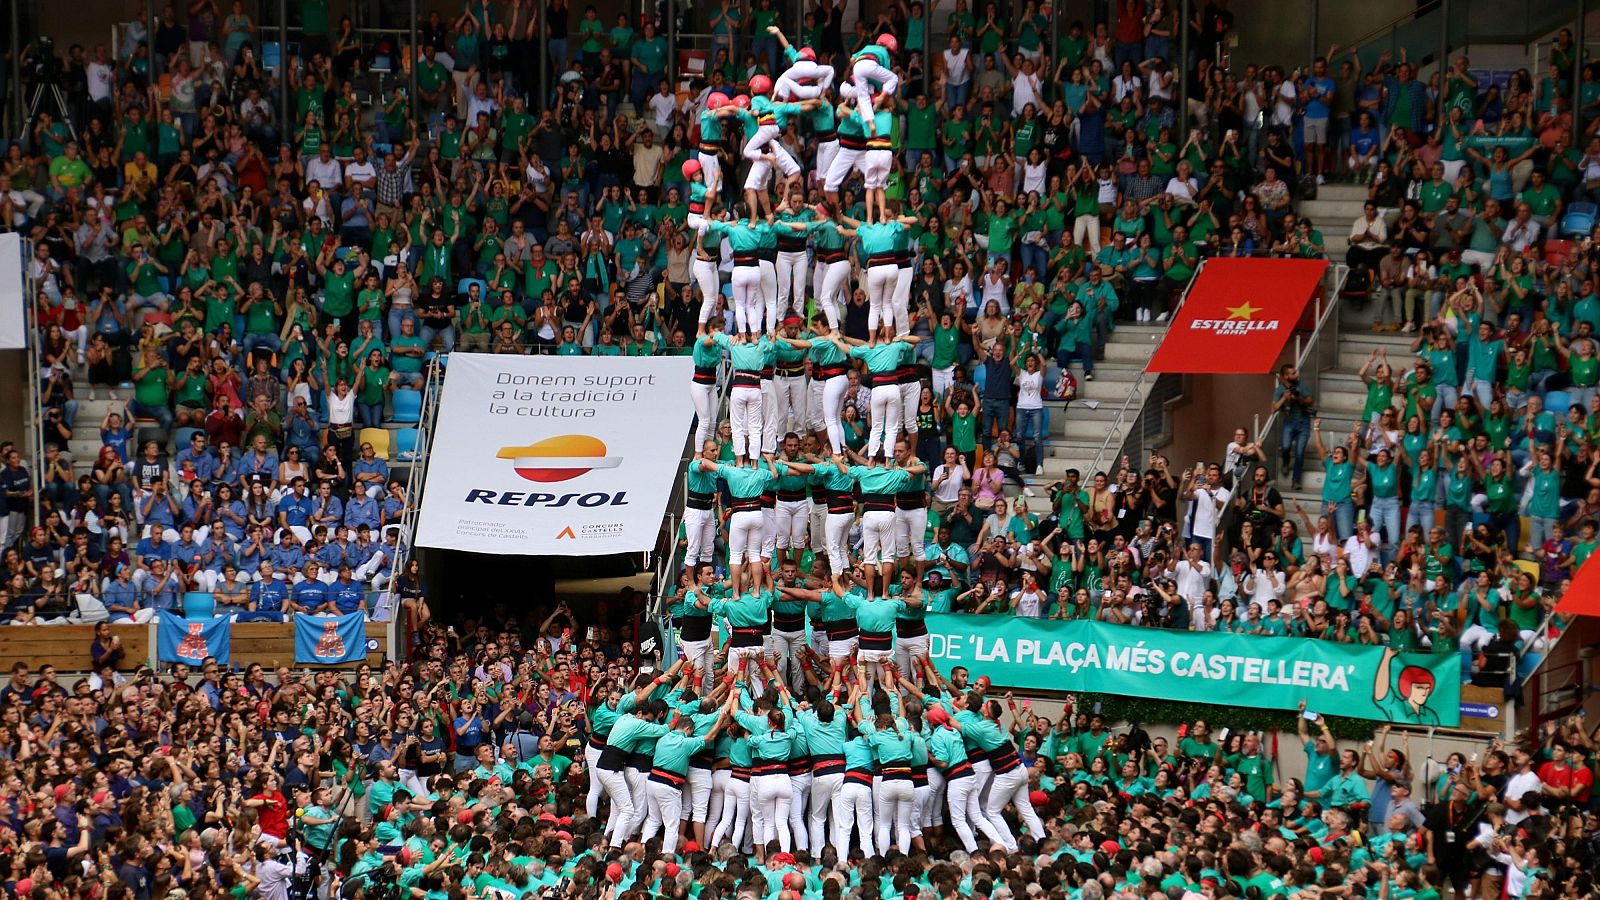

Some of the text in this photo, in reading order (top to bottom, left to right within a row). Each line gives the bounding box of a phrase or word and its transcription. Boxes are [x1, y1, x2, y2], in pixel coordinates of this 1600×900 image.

[1190, 319, 1279, 330] ESTRELLA
[496, 372, 656, 389] Donem suport
[492, 388, 638, 402] a la tradició i
[488, 402, 596, 418] la cultura
[464, 489, 629, 507] REPSOL
[457, 525, 490, 533] principal
[458, 519, 506, 528] Patrocinador
[456, 529, 486, 537] Concurs
[928, 633, 963, 660] DE
[1015, 639, 1102, 674] PLAÇA
[1105, 640, 1166, 675] MÉS
